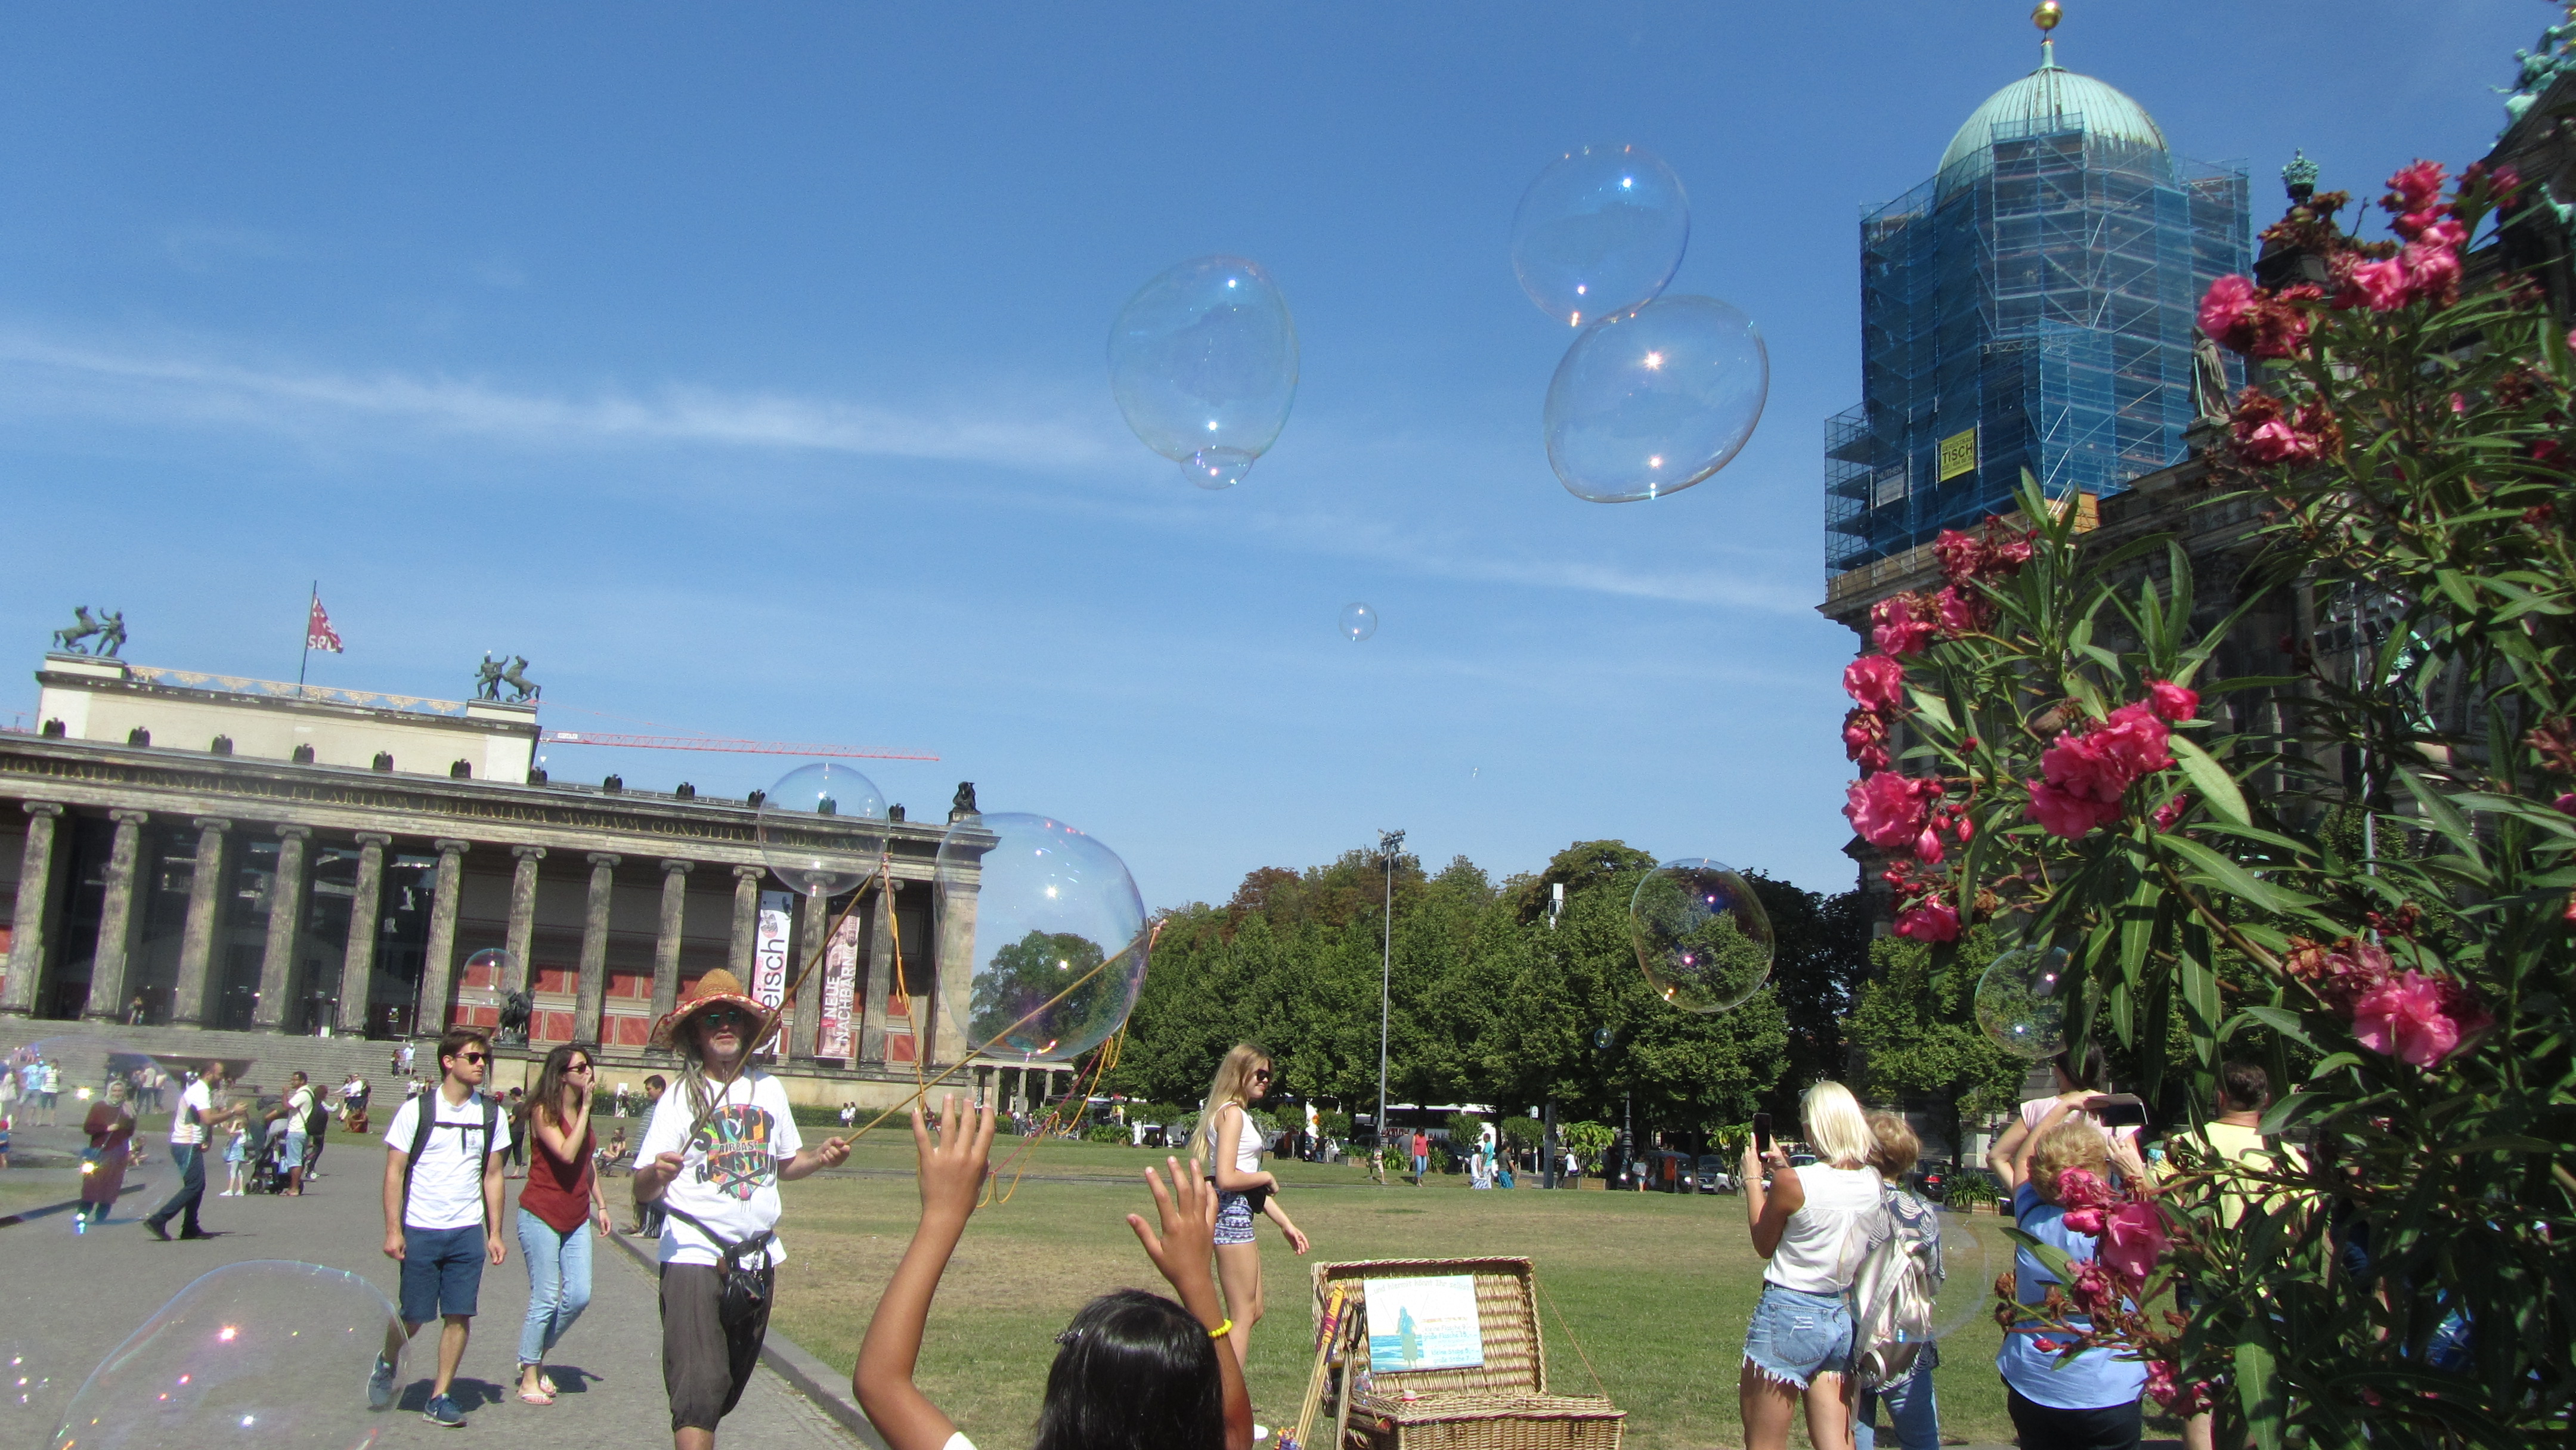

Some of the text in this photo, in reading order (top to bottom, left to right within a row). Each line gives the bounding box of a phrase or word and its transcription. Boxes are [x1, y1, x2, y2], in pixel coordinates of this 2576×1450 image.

[1942, 442, 1973, 464] TISCH
[291, 786, 319, 801] ET
[422, 799, 548, 823] LIBERALIVM
[557, 811, 641, 832] MVSEVM
[651, 820, 770, 844] CONSTITVIT
[823, 976, 840, 1018] NEUE
[836, 956, 854, 1042] NACHBARN
[689, 1108, 775, 1151] STOPP
[719, 1141, 758, 1153] AIRBASE
[1388, 1280, 1411, 1290] hiermit
